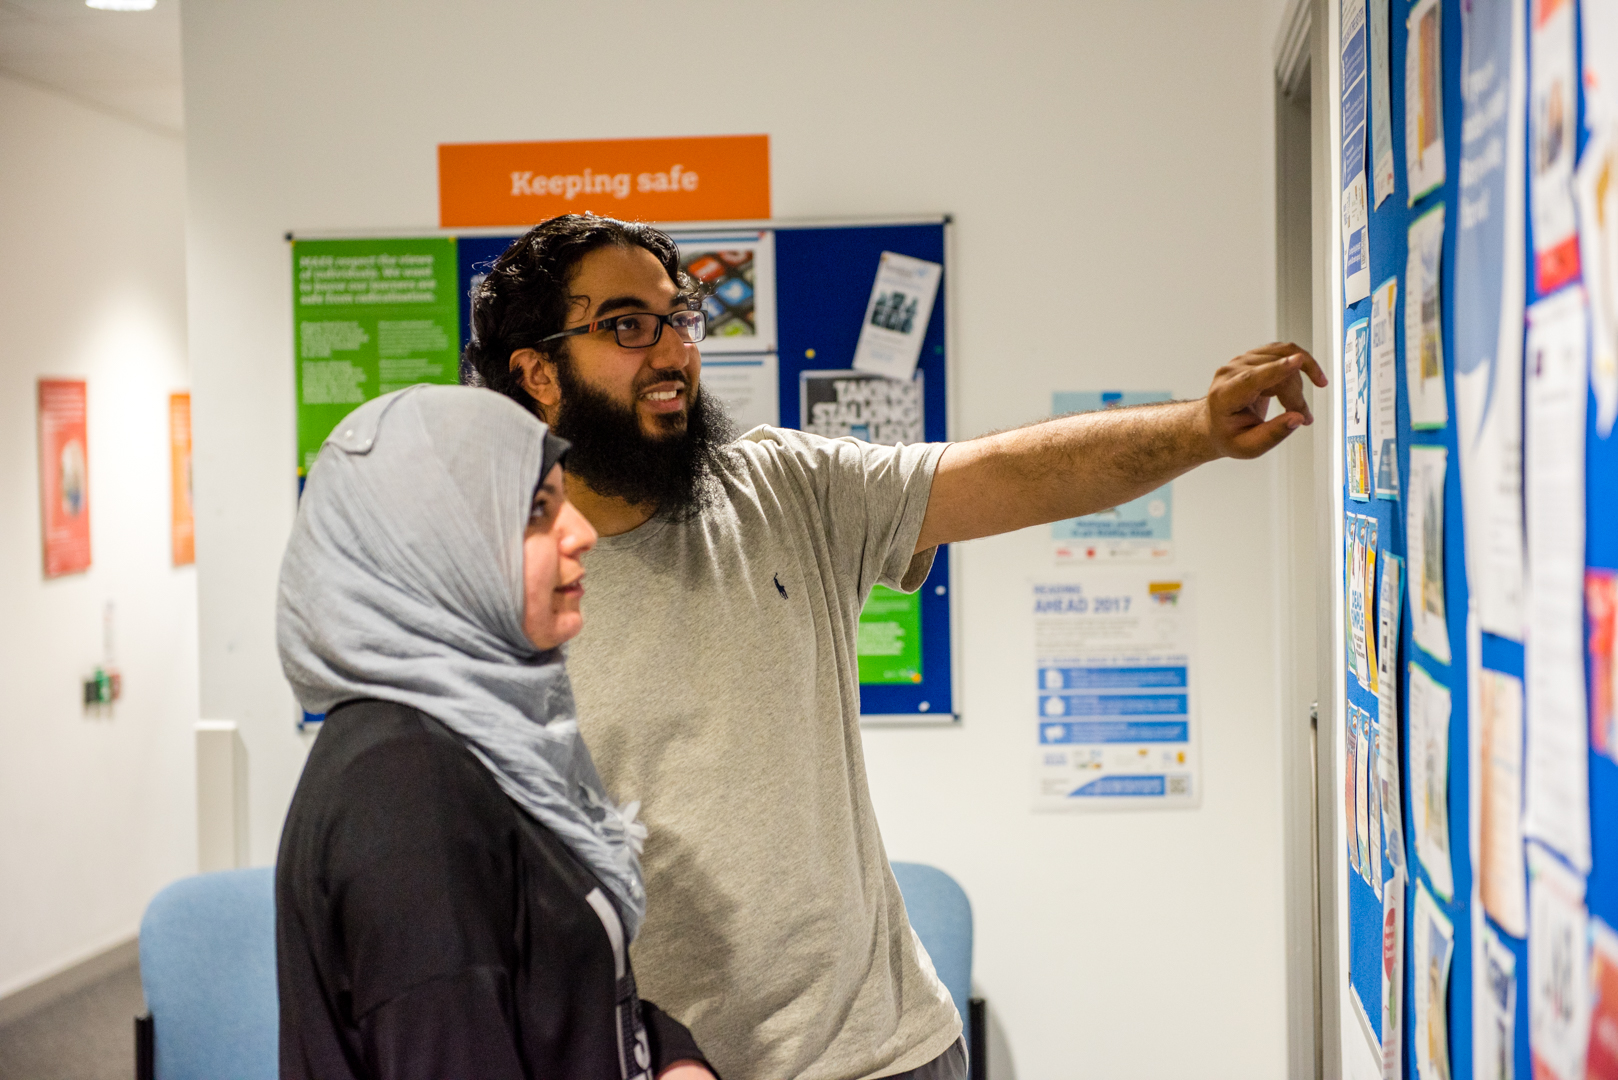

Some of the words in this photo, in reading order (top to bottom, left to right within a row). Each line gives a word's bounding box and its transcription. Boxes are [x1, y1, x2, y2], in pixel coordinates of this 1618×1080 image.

[510, 168, 632, 200] Keeping
[637, 164, 699, 192] safe
[1034, 597, 1088, 613] AHEAD
[1093, 596, 1132, 613] 2017
[1352, 590, 1363, 611] DEAD
[1351, 608, 1364, 632] SIMPLE
